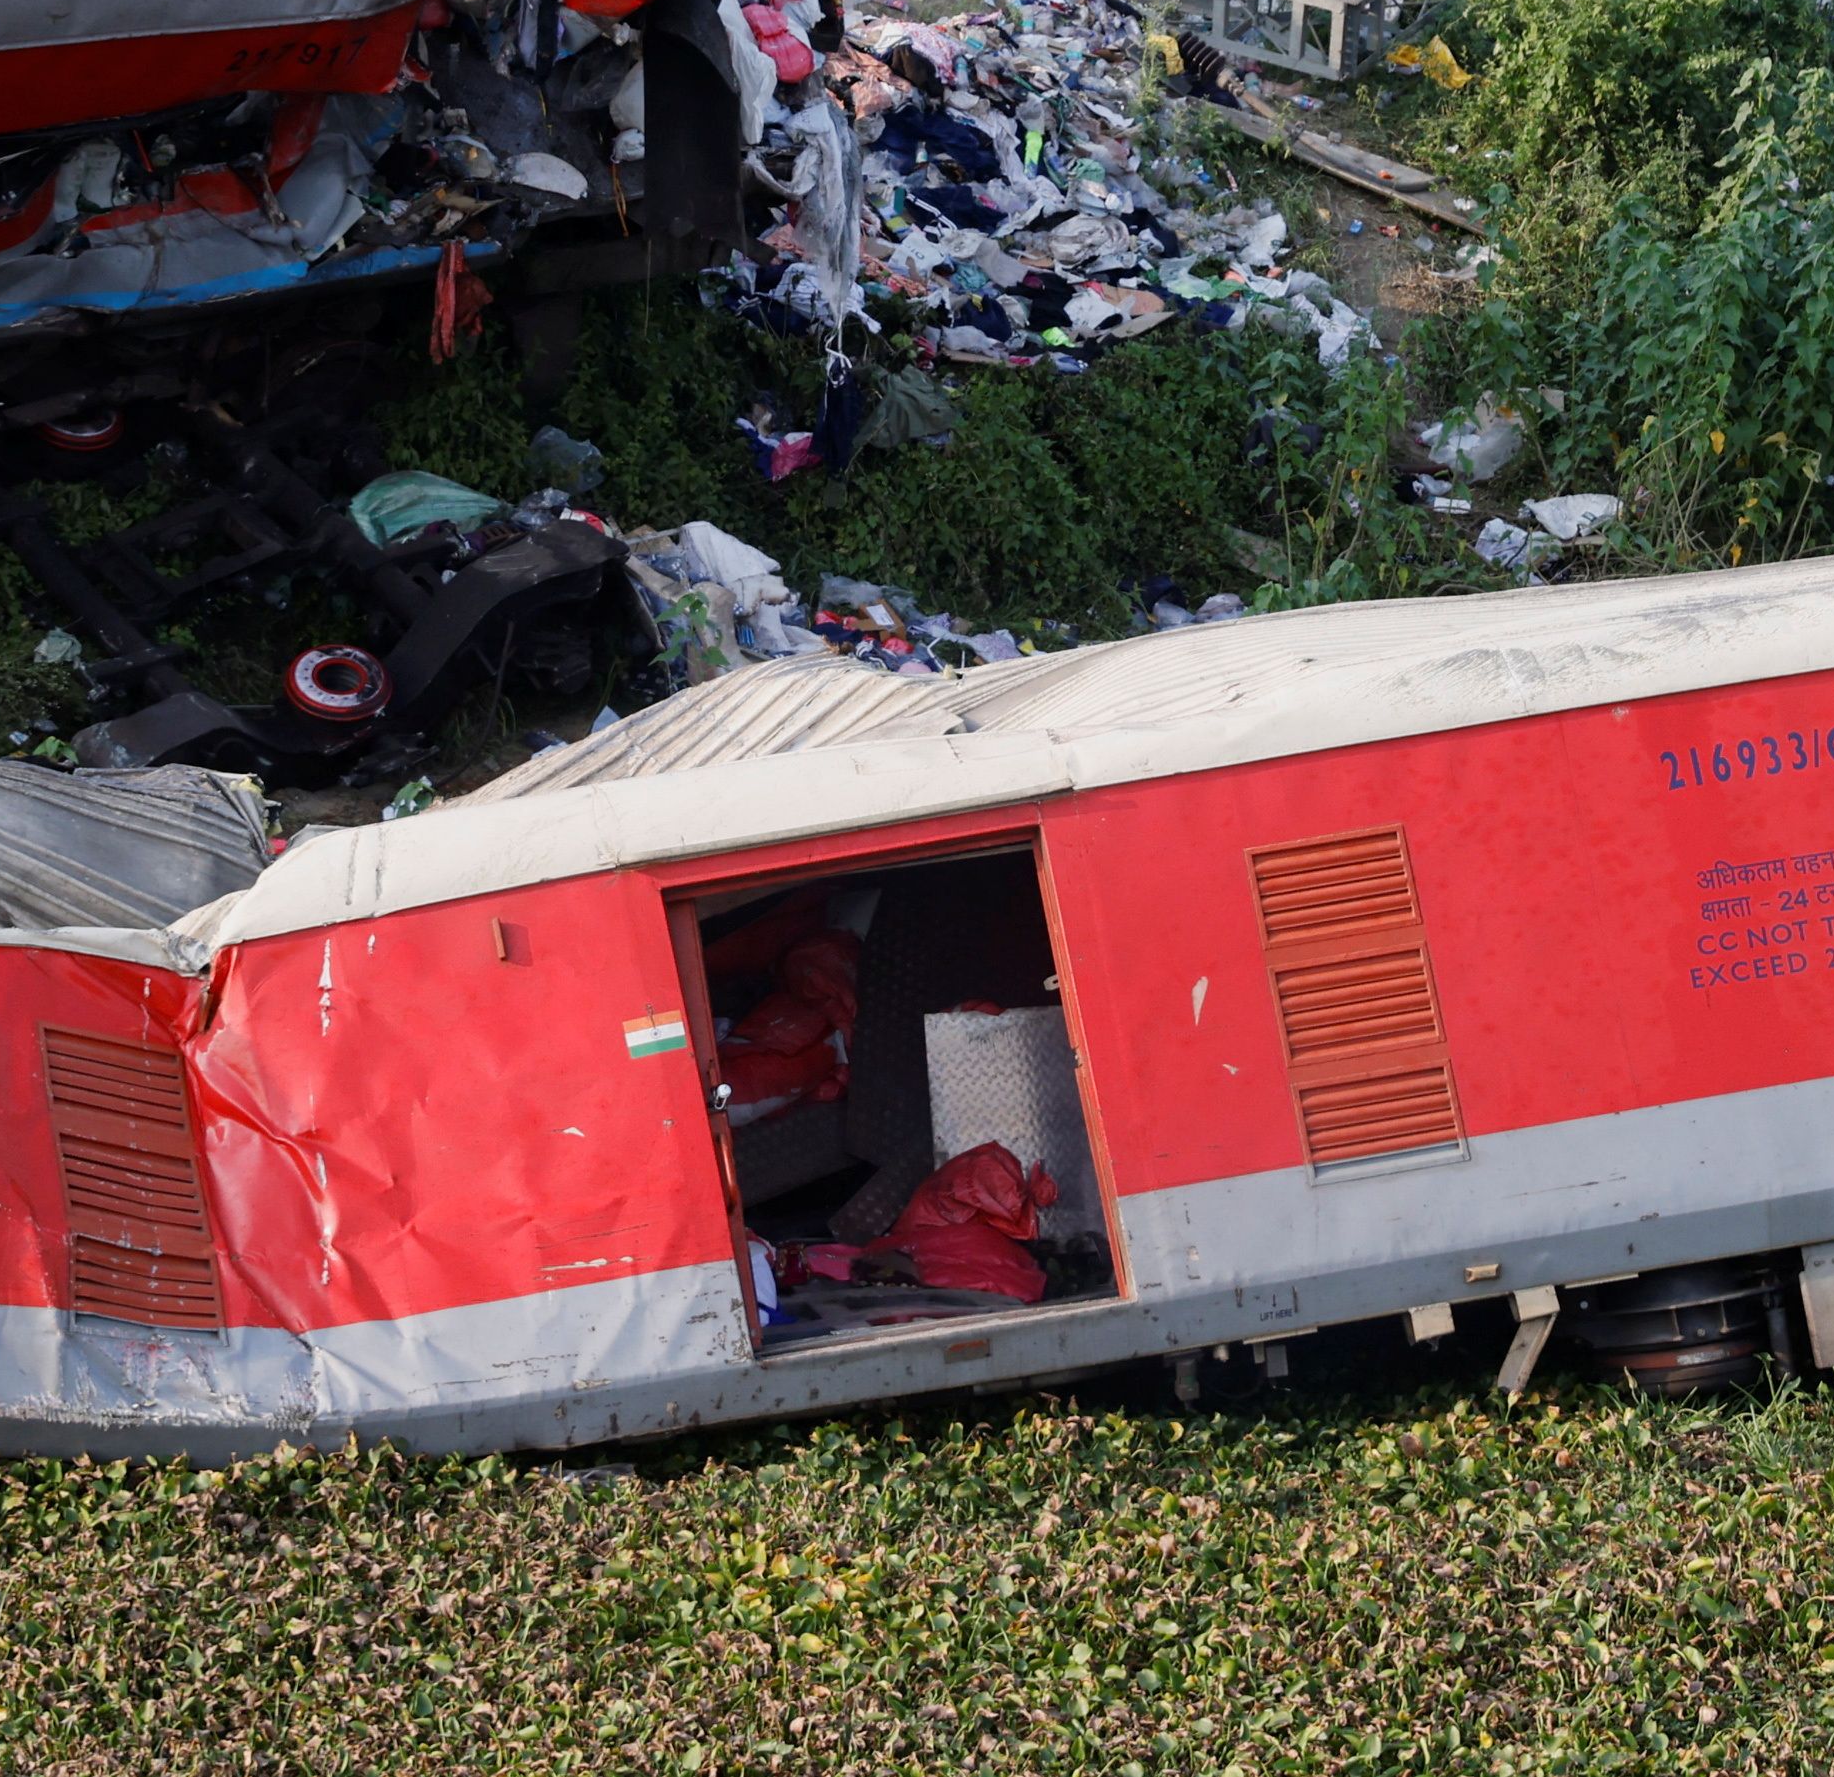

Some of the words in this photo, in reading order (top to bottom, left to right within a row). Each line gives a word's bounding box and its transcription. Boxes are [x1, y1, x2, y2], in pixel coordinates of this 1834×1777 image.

[1697, 858, 1787, 890] अधिकतम
[1701, 895, 1752, 922] क्षमता
[1778, 888, 1810, 912] 24
[1696, 931, 1739, 956] CC
[1746, 919, 1809, 949] NOT
[1689, 952, 1808, 990] EXCEED
